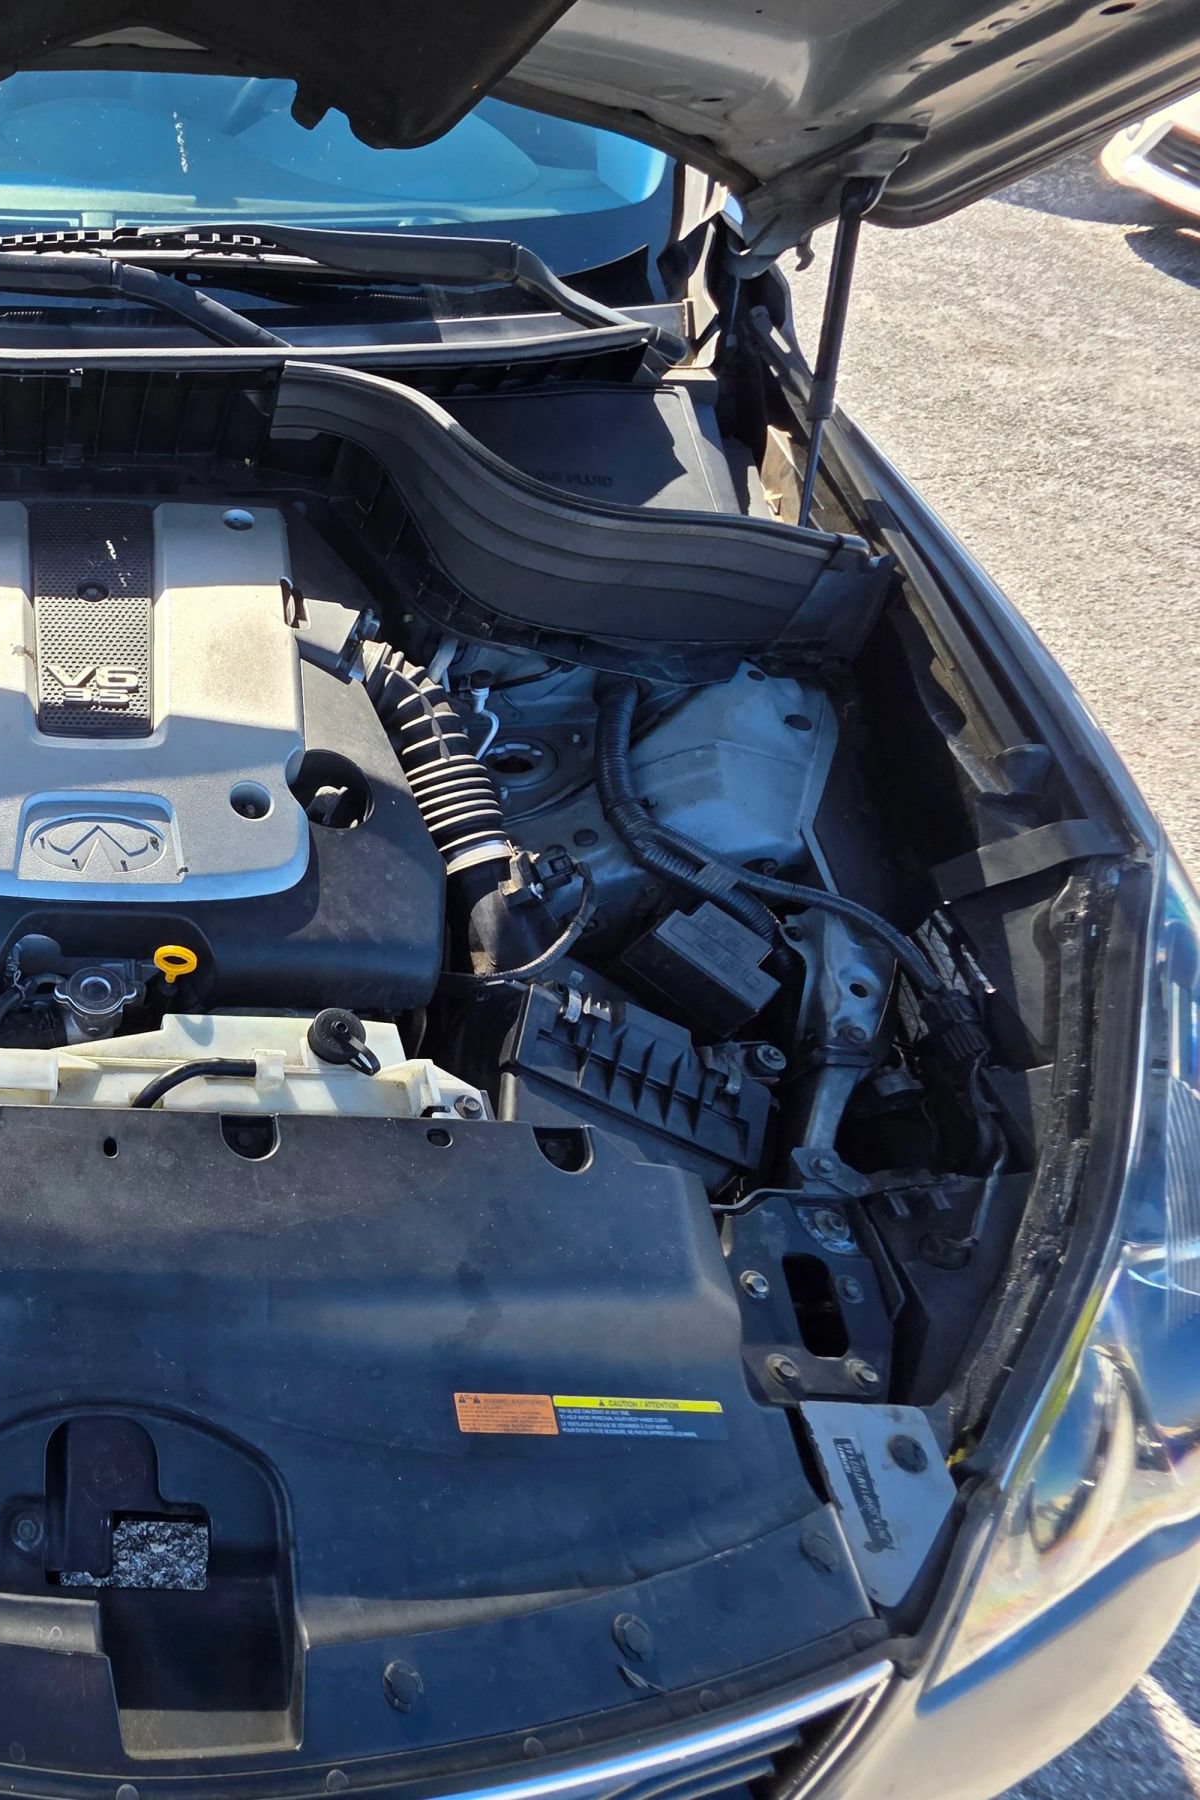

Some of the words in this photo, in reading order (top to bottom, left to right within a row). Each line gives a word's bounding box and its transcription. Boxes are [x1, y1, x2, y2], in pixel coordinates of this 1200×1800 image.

[47, 664, 140, 690] V6
[608, 1399, 638, 1408] CAUTION
[644, 1401, 680, 1410] ATTENTION
